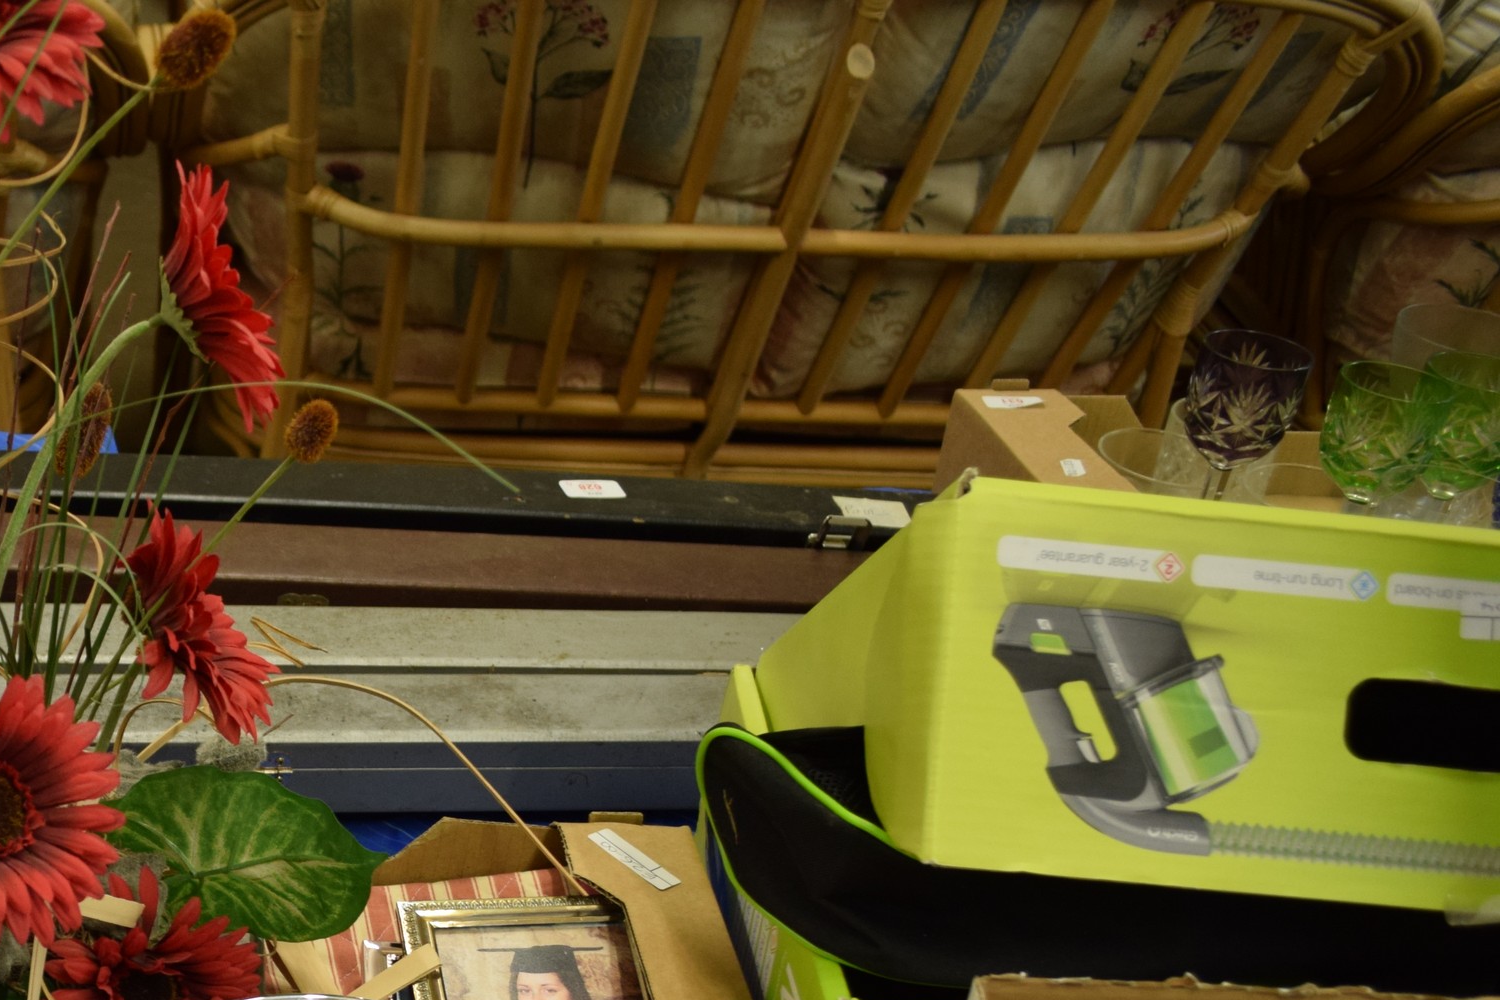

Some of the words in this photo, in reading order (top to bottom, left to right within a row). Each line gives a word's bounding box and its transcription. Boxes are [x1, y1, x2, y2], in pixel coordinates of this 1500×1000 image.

[1108, 554, 1149, 572] 2-year
[1253, 570, 1309, 586] run-time
[1310, 573, 1345, 590] Long
[1394, 583, 1450, 600] on-board
